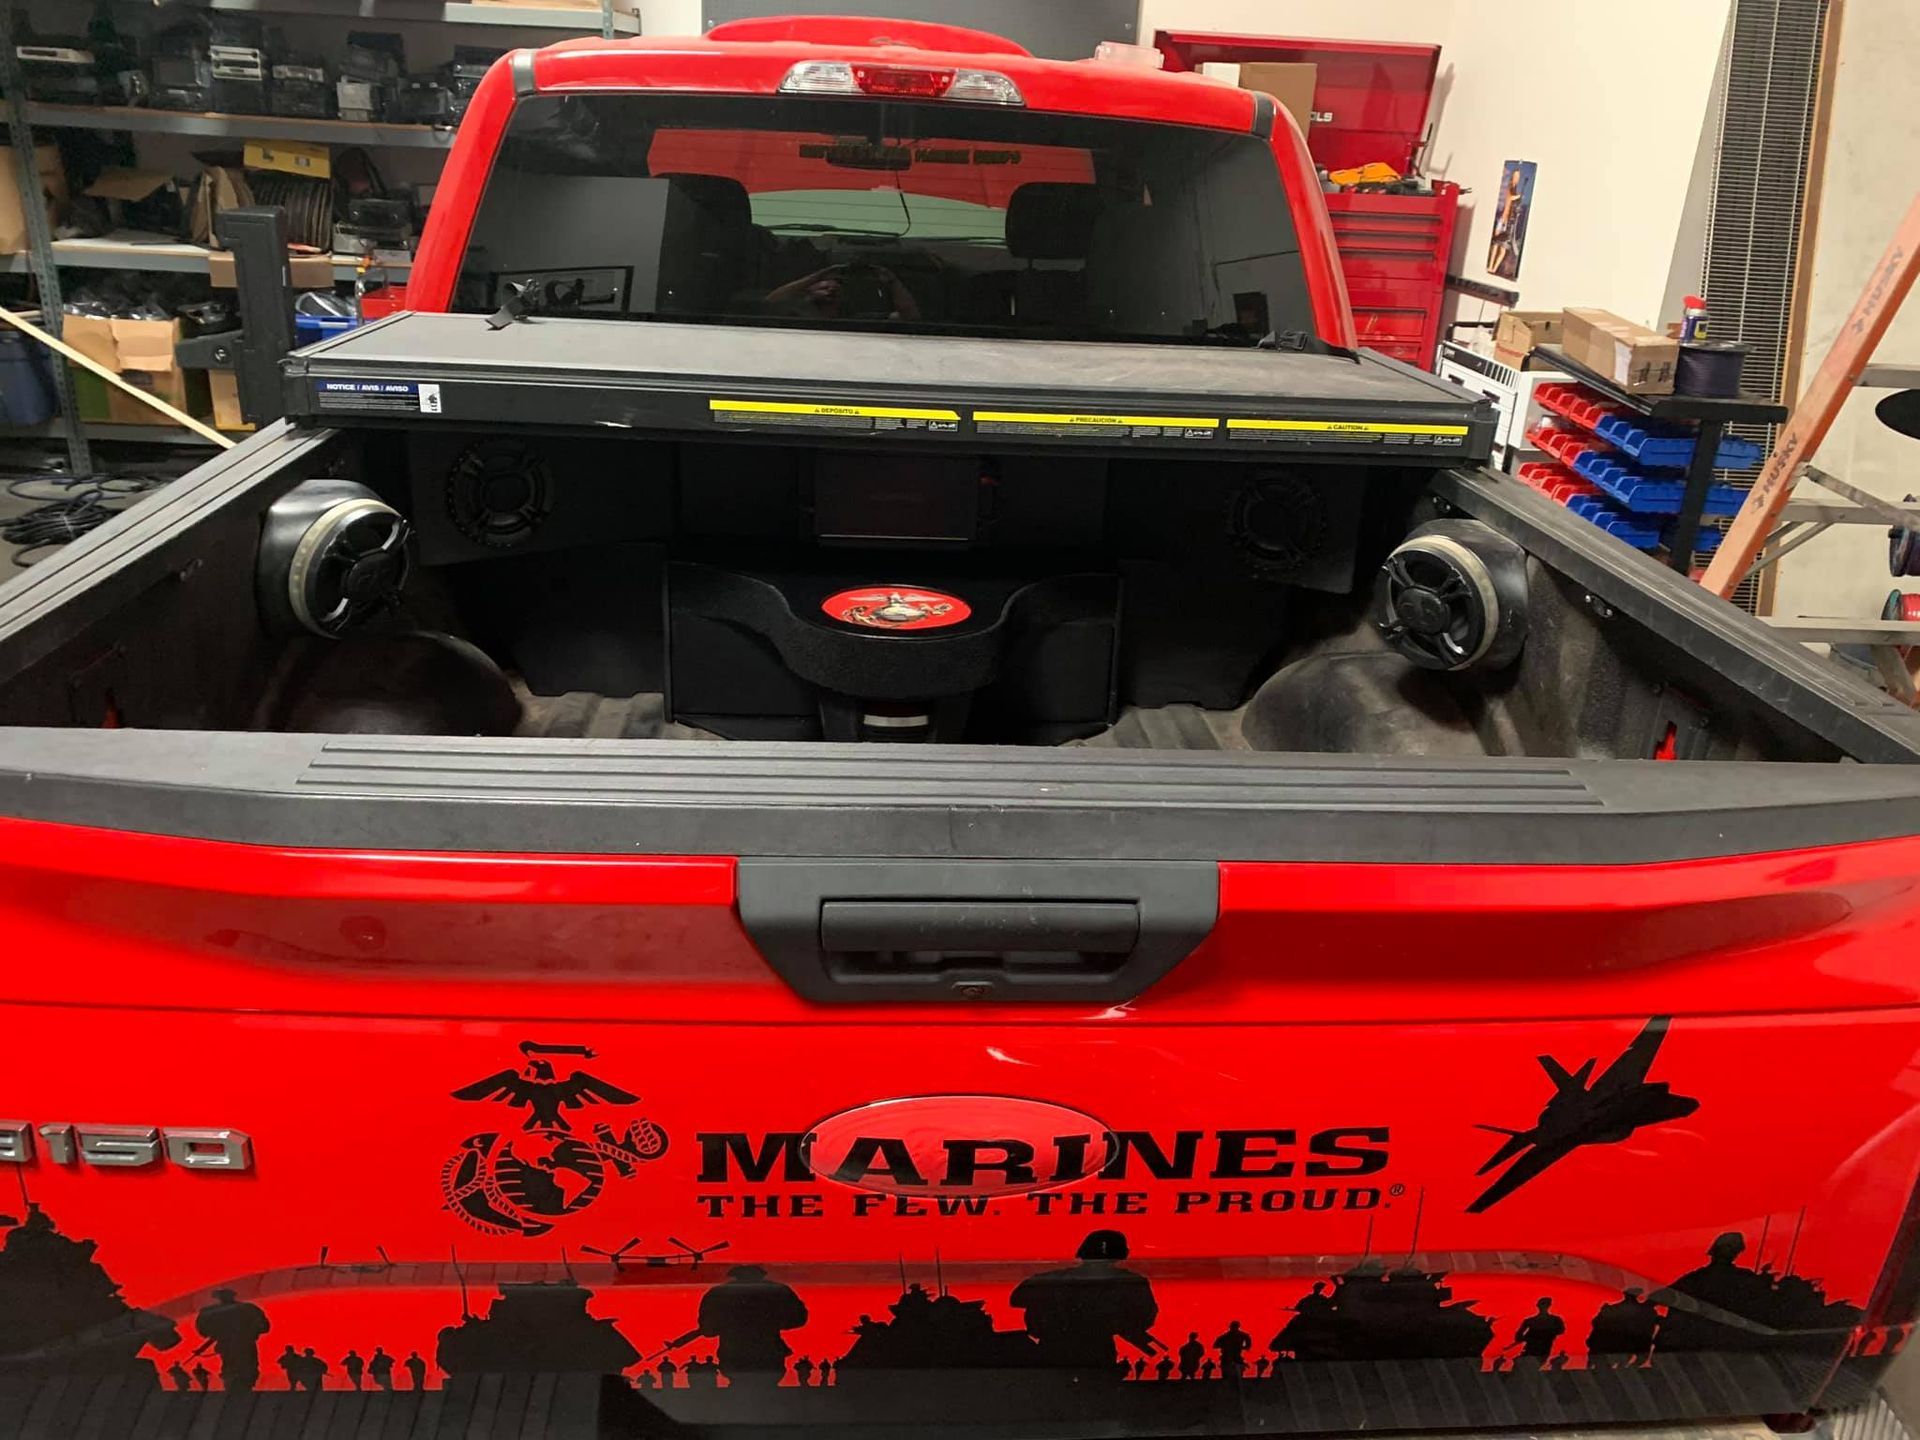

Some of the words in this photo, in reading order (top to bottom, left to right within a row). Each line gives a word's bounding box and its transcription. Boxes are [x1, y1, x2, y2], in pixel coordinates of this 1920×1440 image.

[1310, 111, 1333, 122] OLS
[1864, 246, 1904, 316] HUSKY
[326, 383, 356, 391] NOTICE
[1763, 432, 1799, 496] HUSKY
[696, 1127, 1390, 1186] MARINES
[696, 1194, 824, 1218] THE
[852, 1193, 1002, 1218] FEW.
[1027, 1191, 1149, 1216] THE
